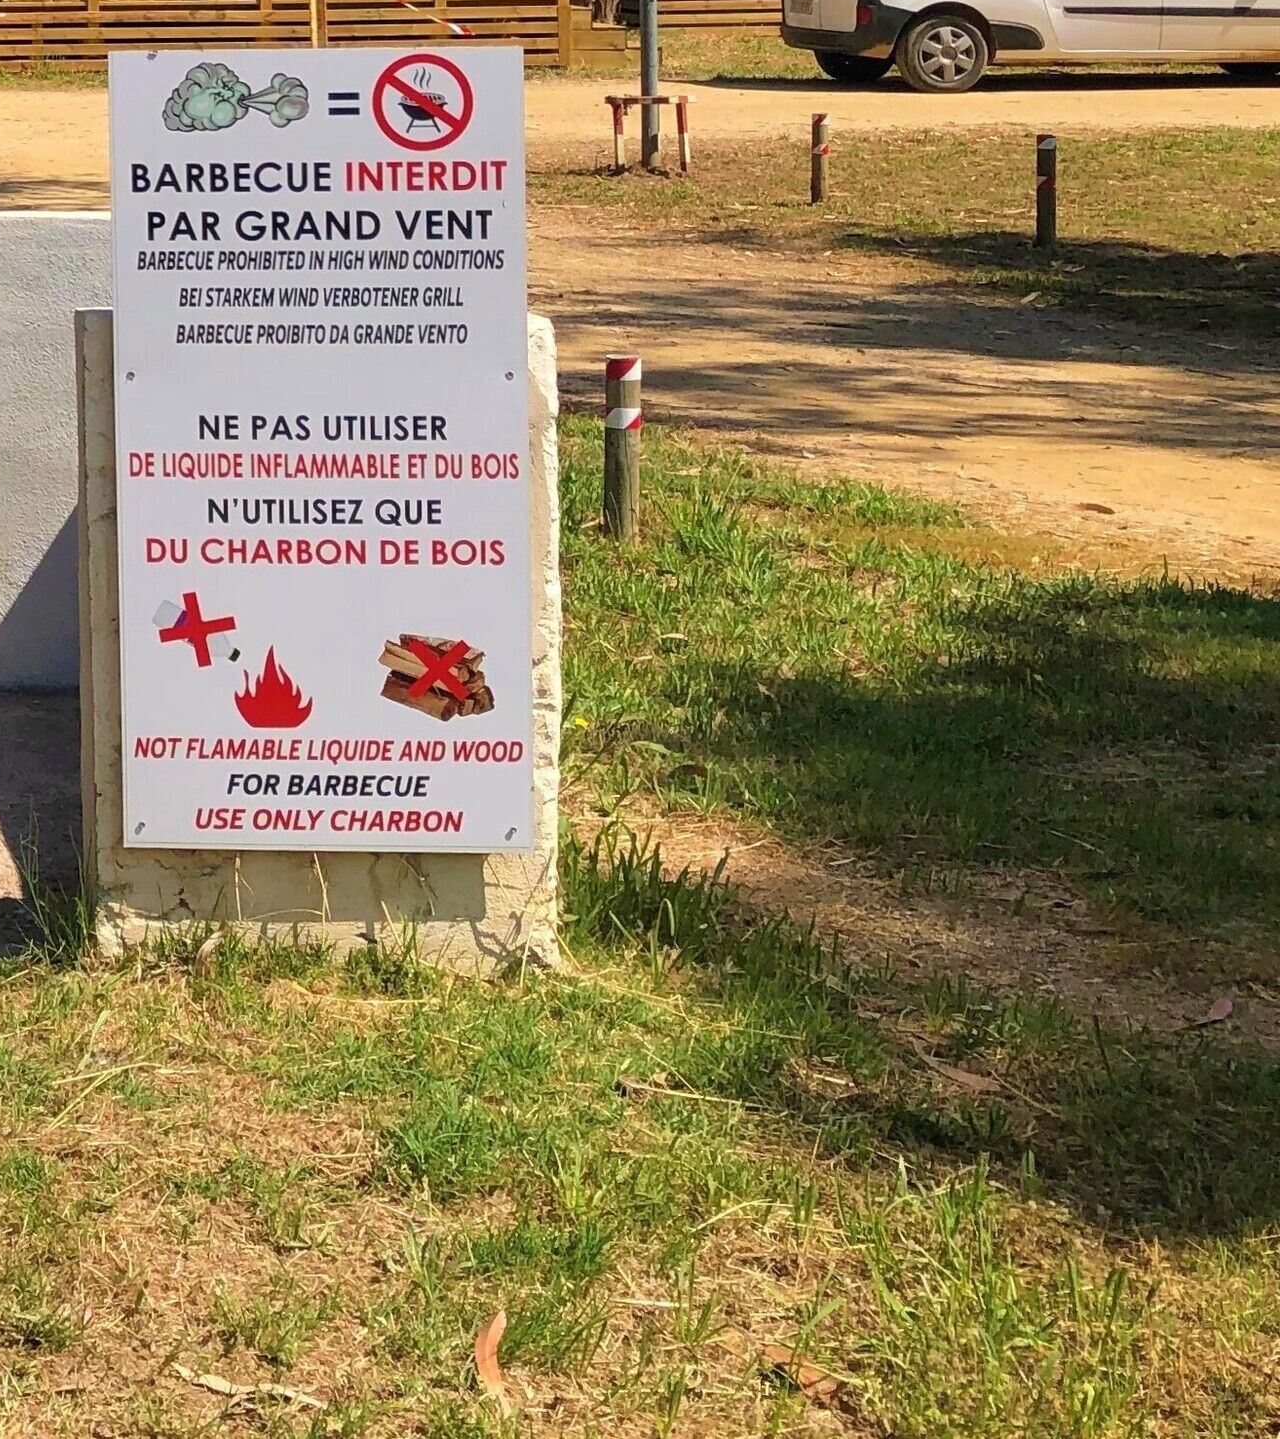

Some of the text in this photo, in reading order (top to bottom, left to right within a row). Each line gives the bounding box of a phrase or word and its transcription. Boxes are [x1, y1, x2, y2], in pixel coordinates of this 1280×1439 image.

[132, 161, 507, 193] BARBECUE INTERDIT
[148, 210, 492, 241] PAR GRAND VENT
[138, 250, 504, 270] BARBECUE PROHIBITED IN HIGH WIND CONDITIONS
[179, 287, 463, 307] BEI STARKEM WIND VERBOTENER GRILL
[177, 324, 467, 344] BARBECUE PROIBITO DA GRANDE VENTO
[199, 415, 447, 441] NE PAS UTILISER
[130, 453, 519, 479] DE LIQUIDE INFLAMMABLE ET DU BOIS
[375, 499, 441, 526] QUE
[147, 538, 504, 565] DU CHARBON DE BOIS
[135, 737, 523, 765] NOT FLAMABLE LIQUIDE AND WOOD
[227, 774, 430, 797] FOR BARBECUE
[196, 808, 463, 832] USE ONLY CHARBON
